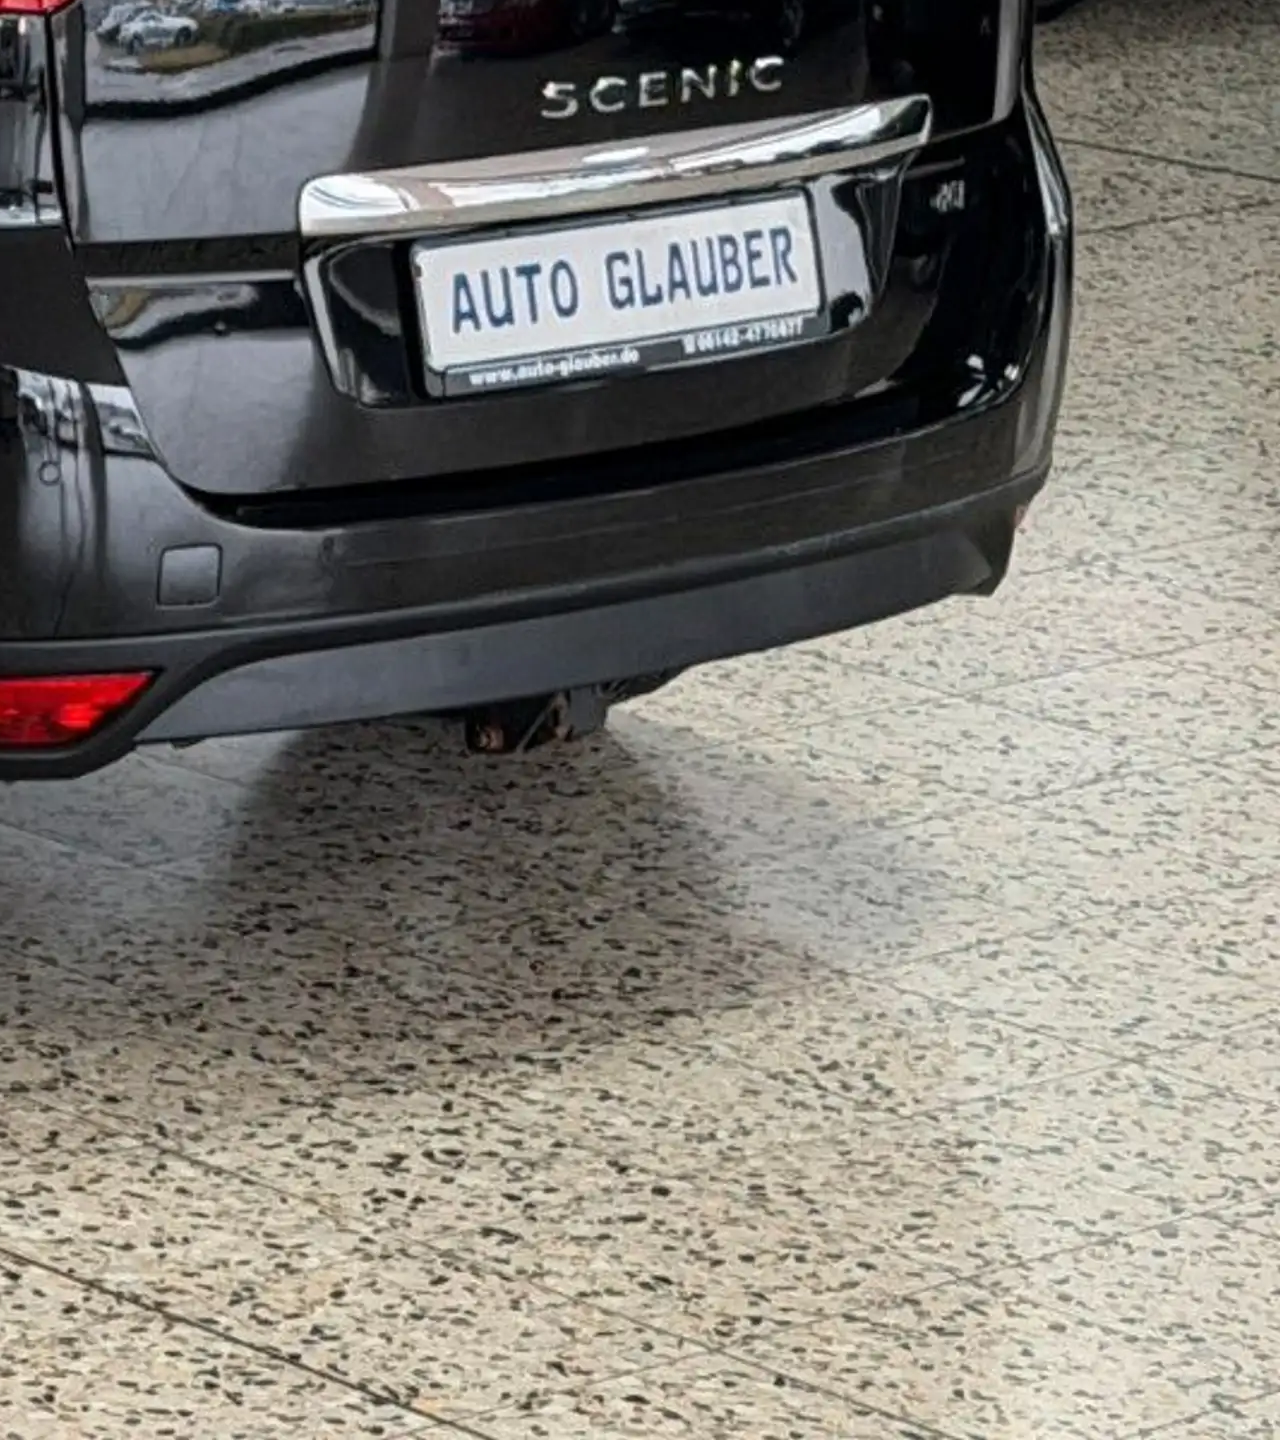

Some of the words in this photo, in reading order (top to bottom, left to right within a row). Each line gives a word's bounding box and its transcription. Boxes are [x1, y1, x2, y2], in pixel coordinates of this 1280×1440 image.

[541, 54, 785, 119] SCENIC
[452, 259, 579, 334] AUTO
[605, 225, 798, 310] GLAUBER
